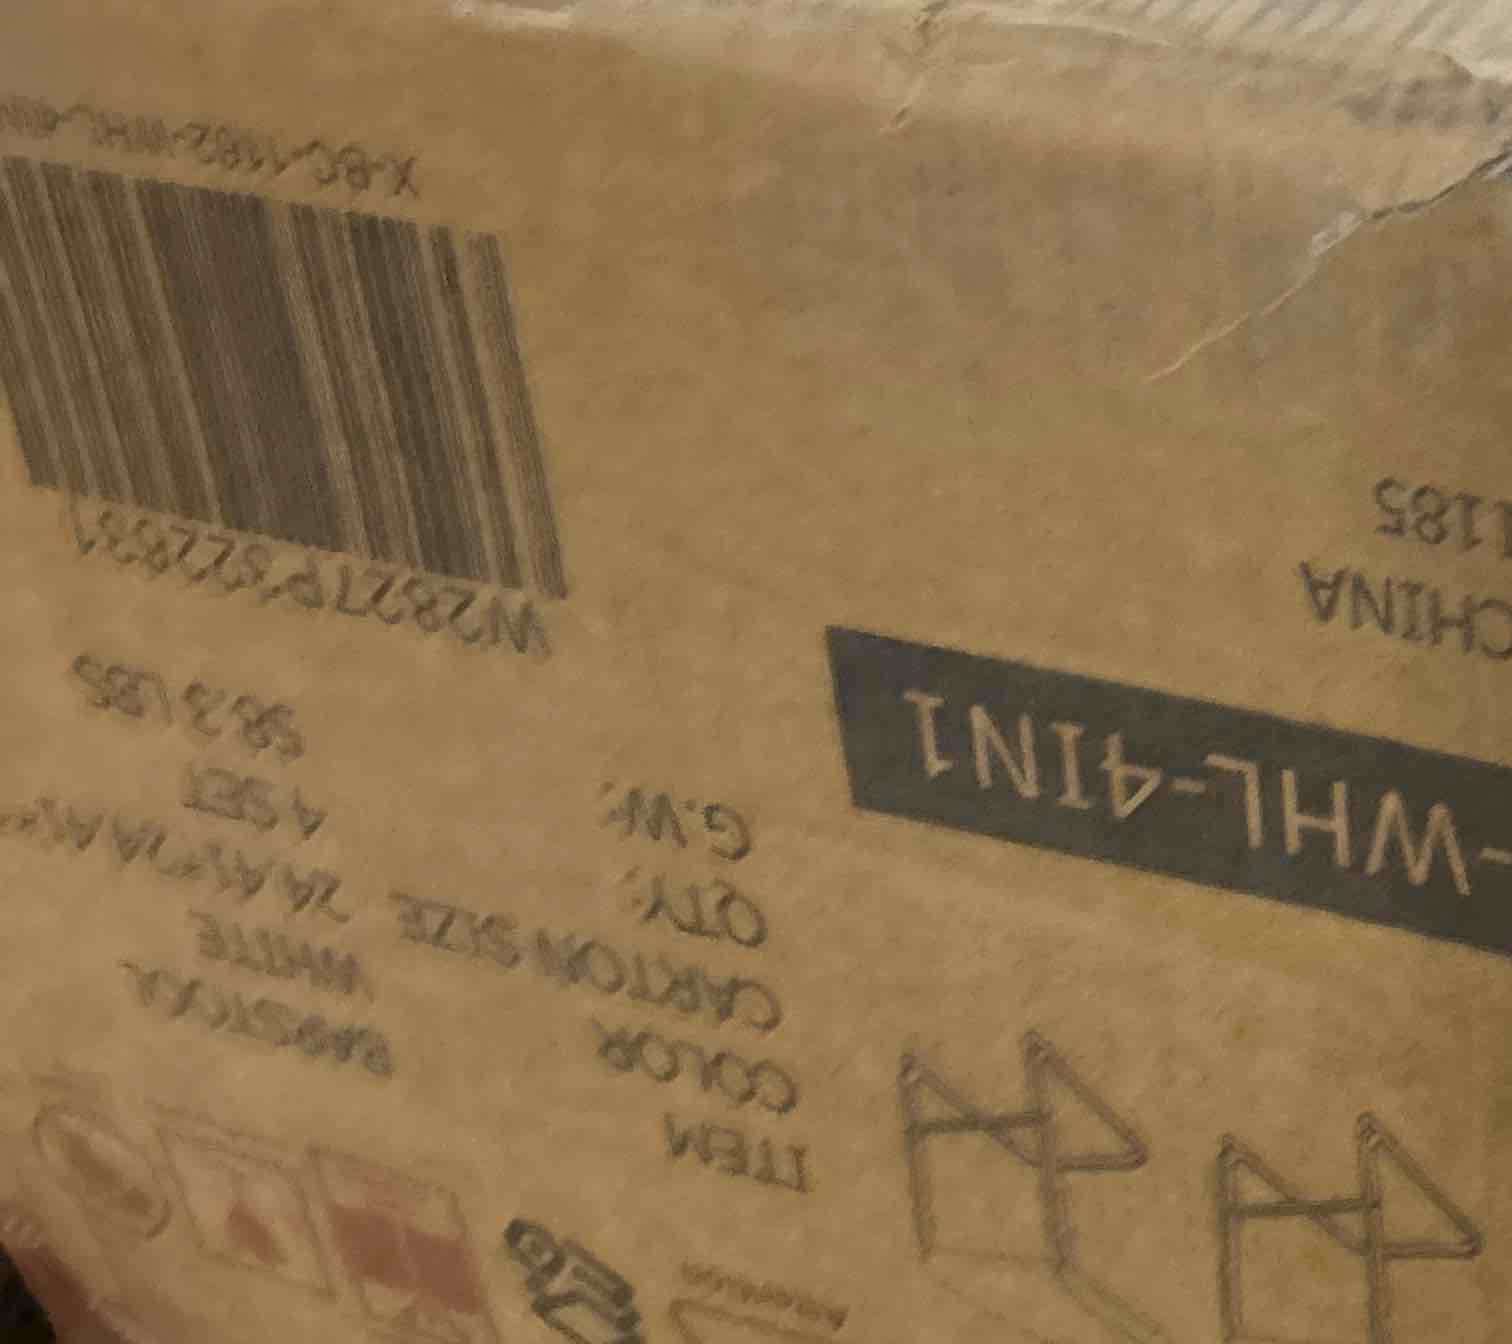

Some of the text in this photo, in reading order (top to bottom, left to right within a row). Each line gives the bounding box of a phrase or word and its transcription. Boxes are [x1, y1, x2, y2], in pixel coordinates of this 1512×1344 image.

[388, 889, 784, 1033] CARTON SIZE
[591, 1013, 800, 1116] COLOR
[663, 1112, 812, 1194] ITEM
